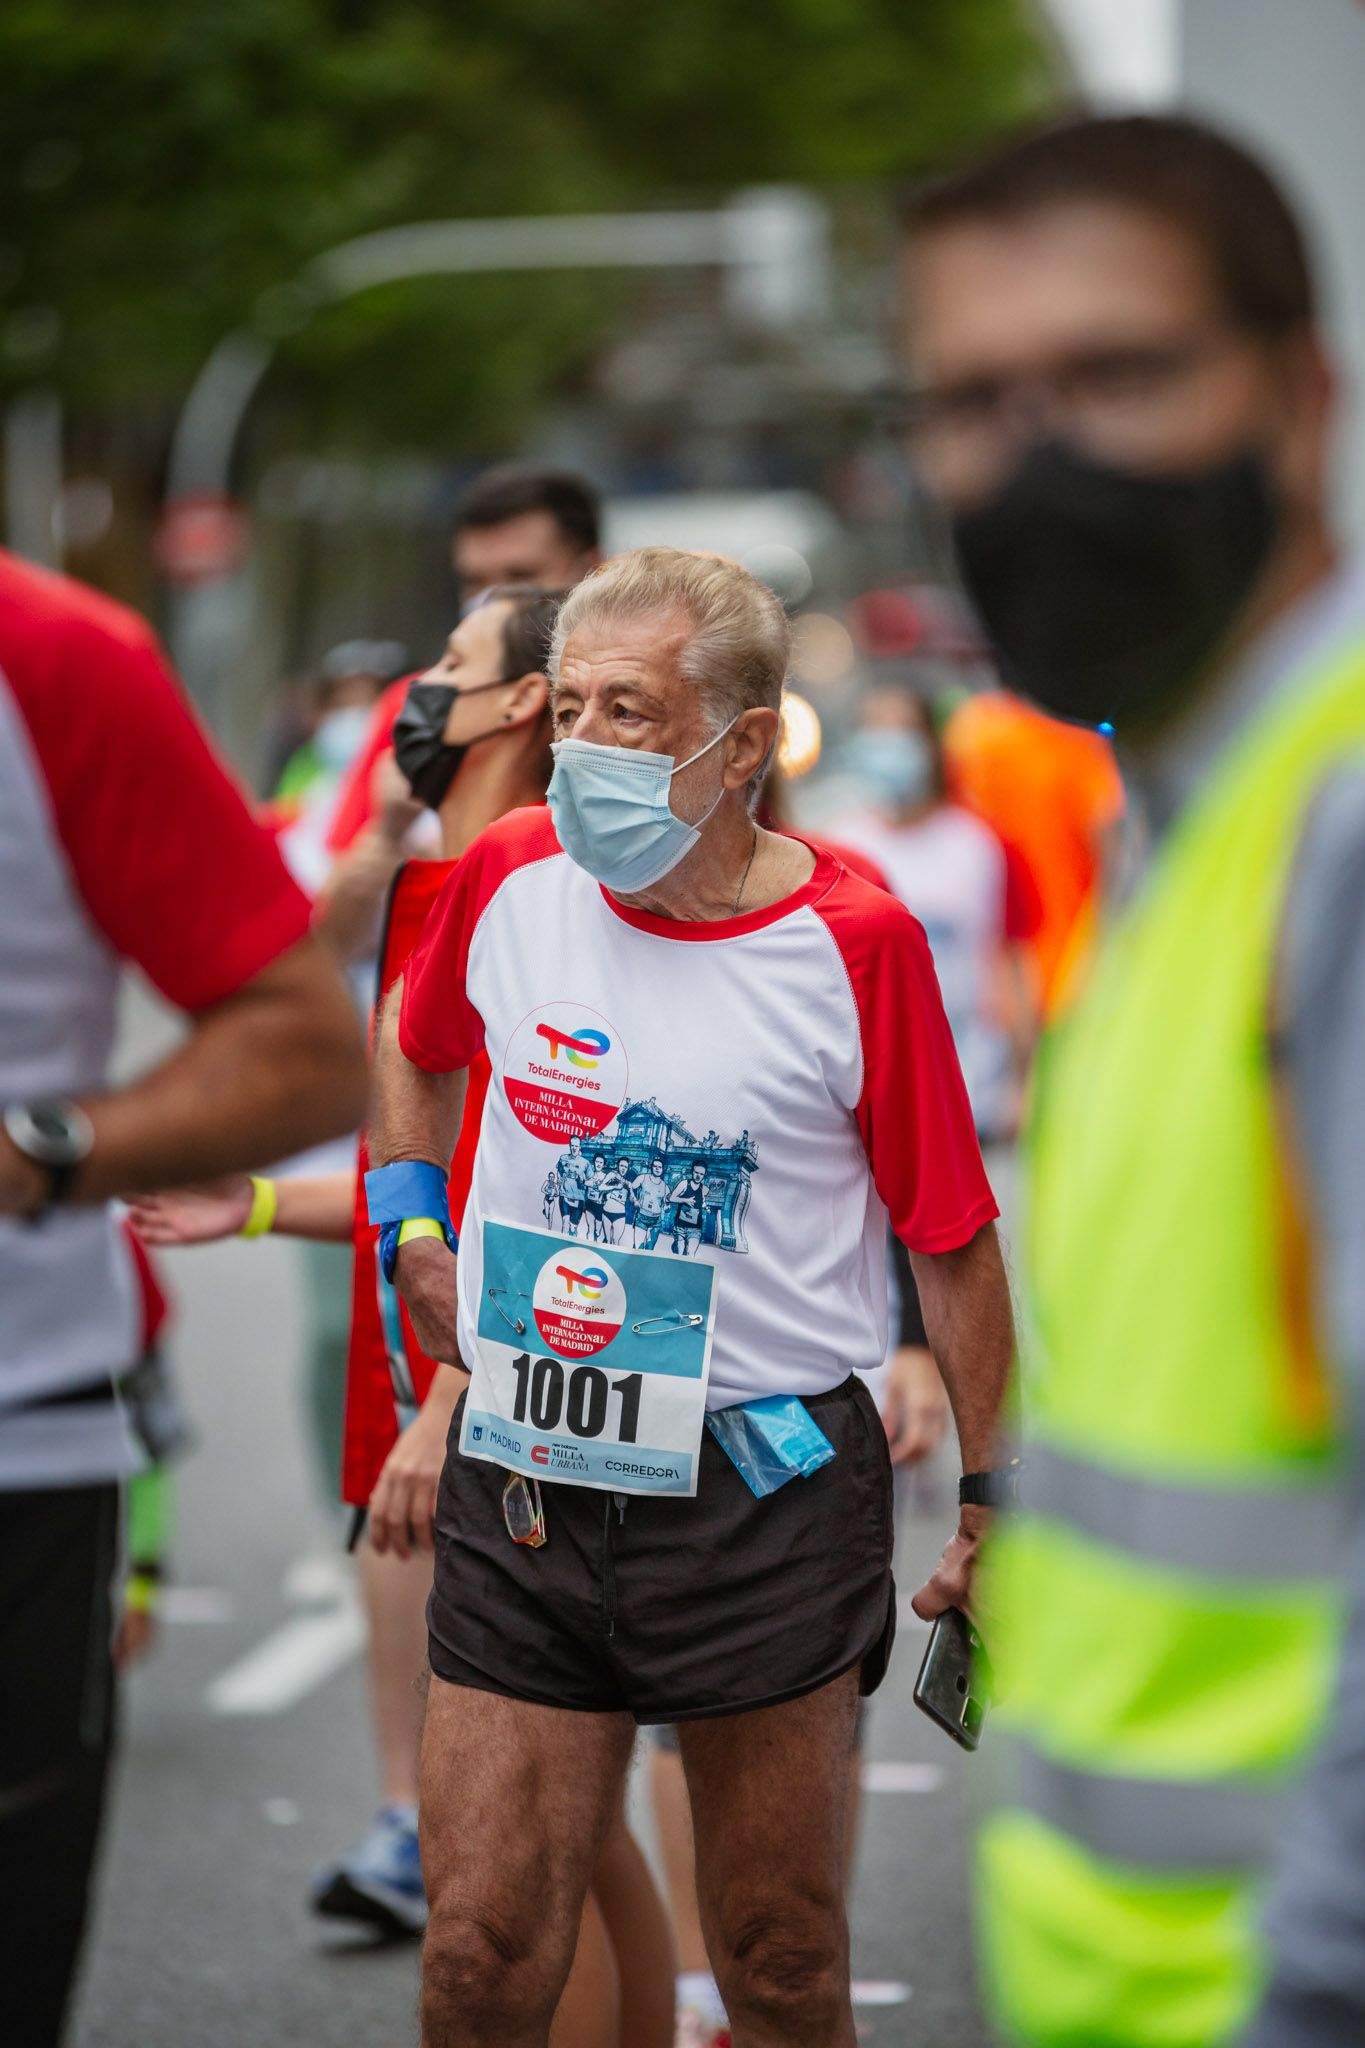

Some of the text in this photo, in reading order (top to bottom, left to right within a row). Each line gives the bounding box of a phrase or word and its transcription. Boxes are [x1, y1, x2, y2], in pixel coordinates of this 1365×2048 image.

[528, 1062, 602, 1091] TotalEnergies
[539, 1091, 573, 1109] MILLA
[524, 1113, 584, 1137] DE MADRID
[551, 1297, 606, 1315] TotalEnergies
[560, 1318, 584, 1332] MILLA
[549, 1335, 594, 1352] DE MADRID
[512, 1353, 643, 1443] 1001
[490, 1431, 522, 1453] MADRID
[552, 1448, 585, 1461] MILLA
[550, 1458, 590, 1472] URBANA
